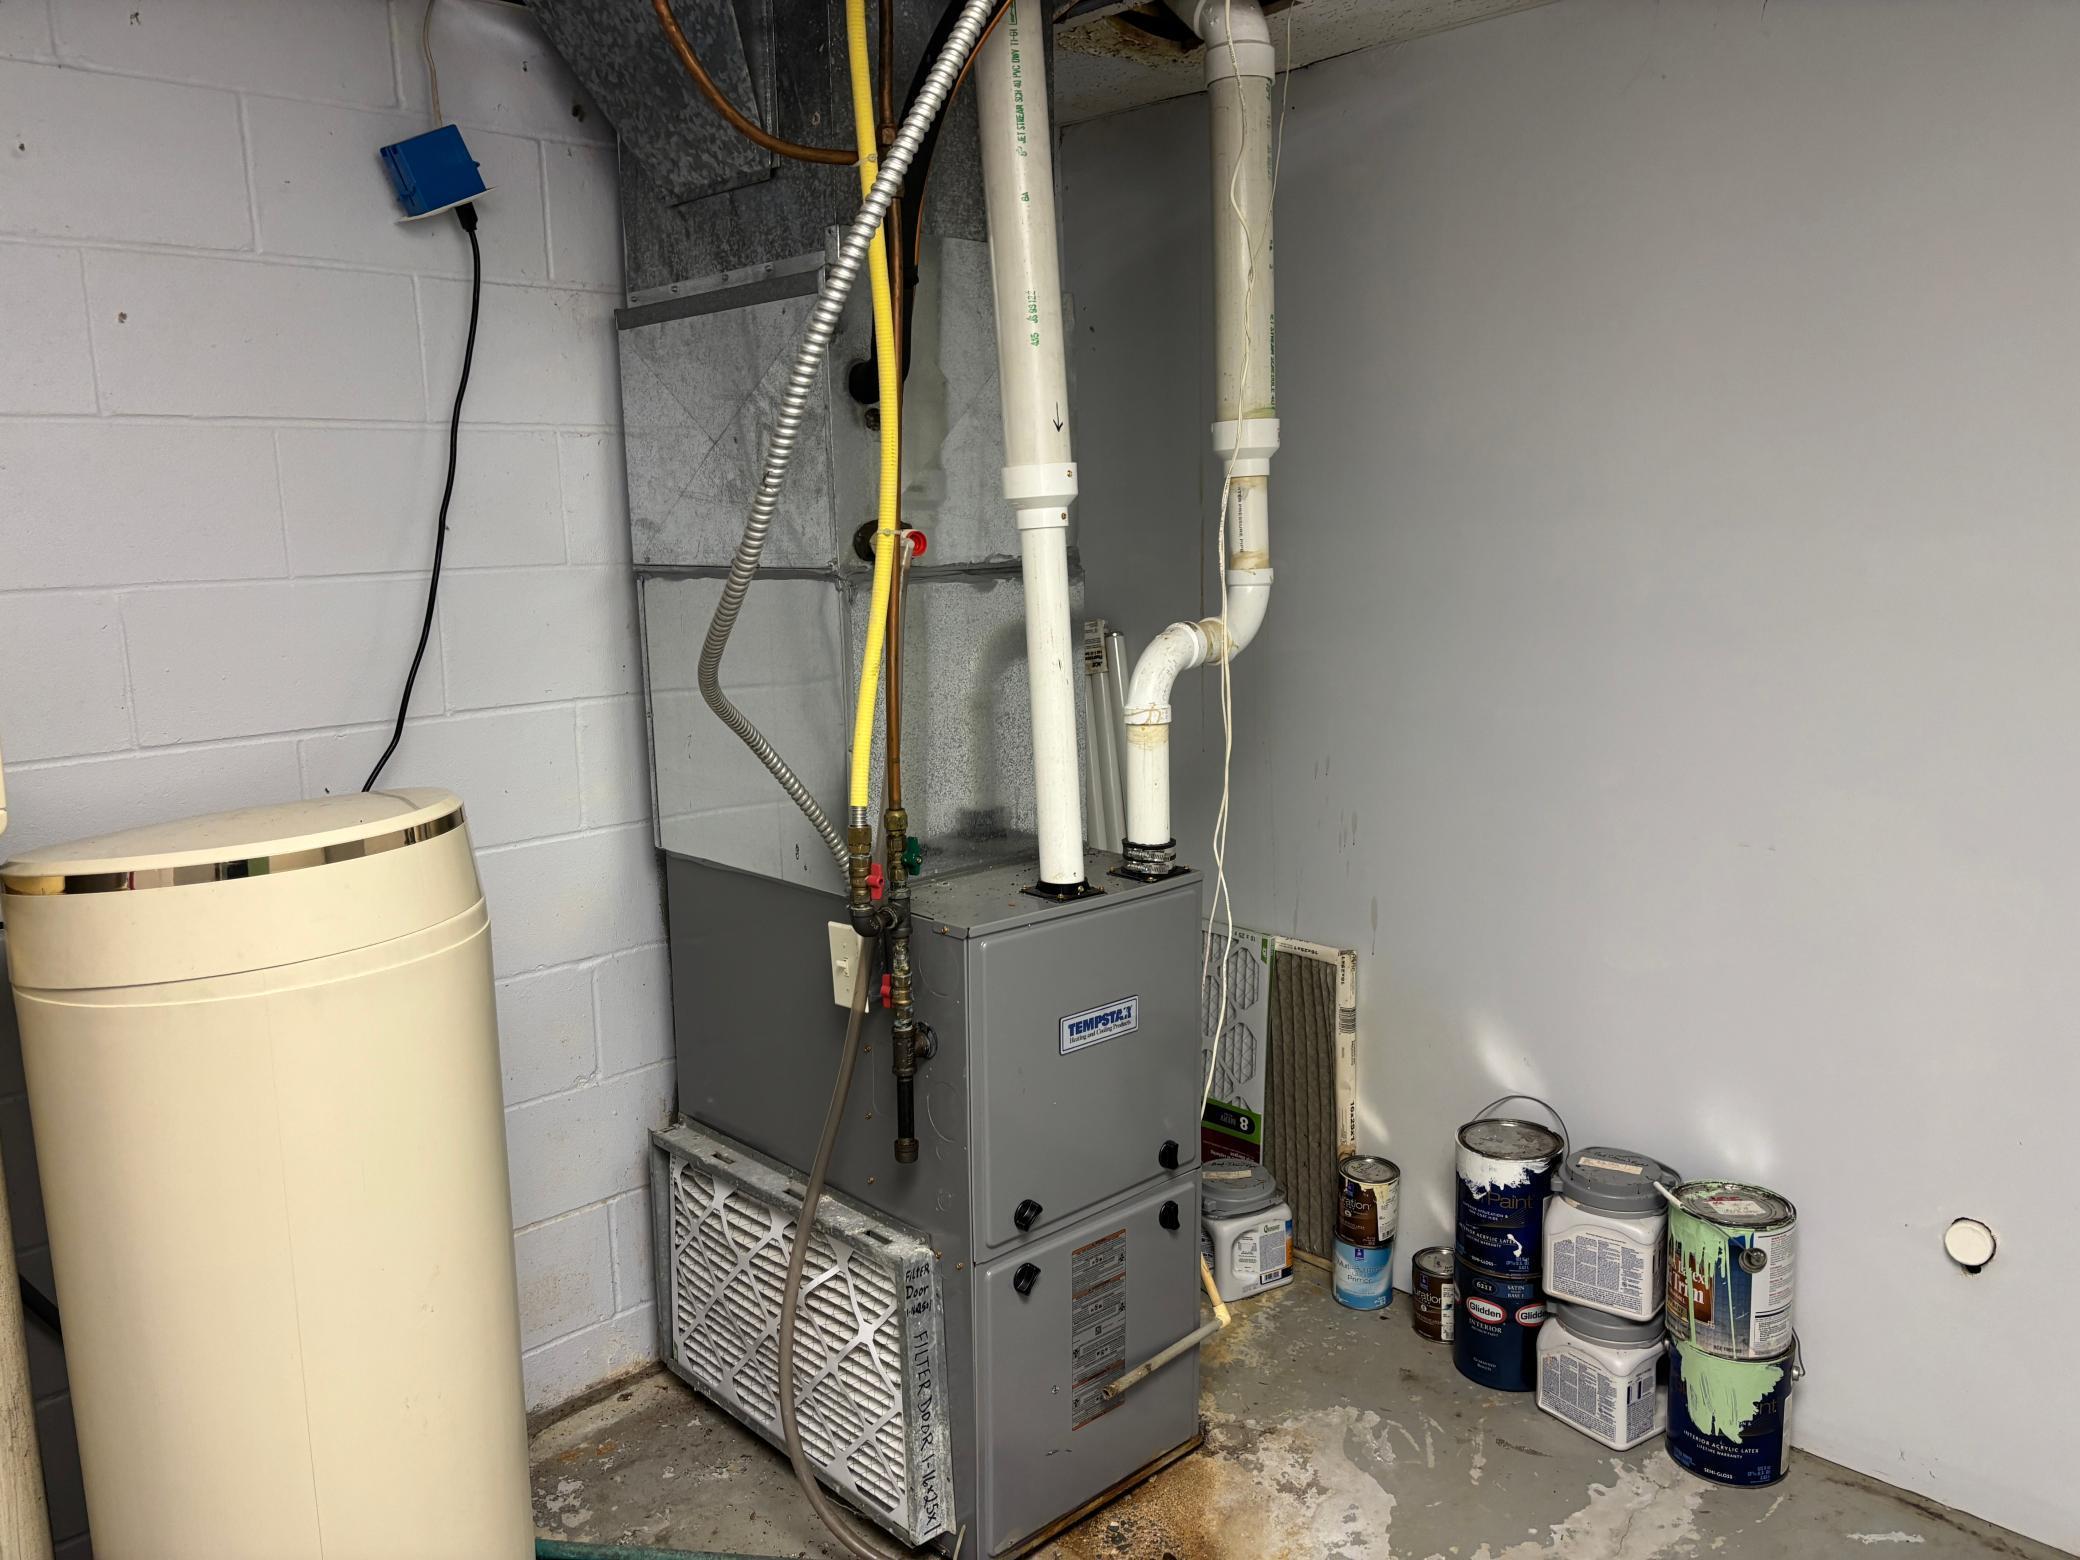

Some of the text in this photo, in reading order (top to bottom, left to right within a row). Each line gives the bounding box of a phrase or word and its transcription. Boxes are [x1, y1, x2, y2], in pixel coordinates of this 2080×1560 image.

[1011, 64, 1021, 78] PVC
[1067, 1004, 1133, 1037] TEMPSTAR
[1069, 1019, 1132, 1044] Heating and Cooling Products
[1239, 1116, 1249, 1131] 8
[905, 1285, 930, 1300] Door
[1469, 1301, 1502, 1319] Glidden
[1468, 1318, 1502, 1334] INTERIOR
[913, 1330, 931, 1397] FILTER
[917, 1394, 934, 1451] DOOR
[1683, 1429, 1710, 1446] INTERIOR
[1711, 1442, 1739, 1453] ACRYLIC
[1696, 1443, 1743, 1460] LIFETIME WARRANTY
[1703, 1467, 1733, 1480] SEMI-GLOSS
